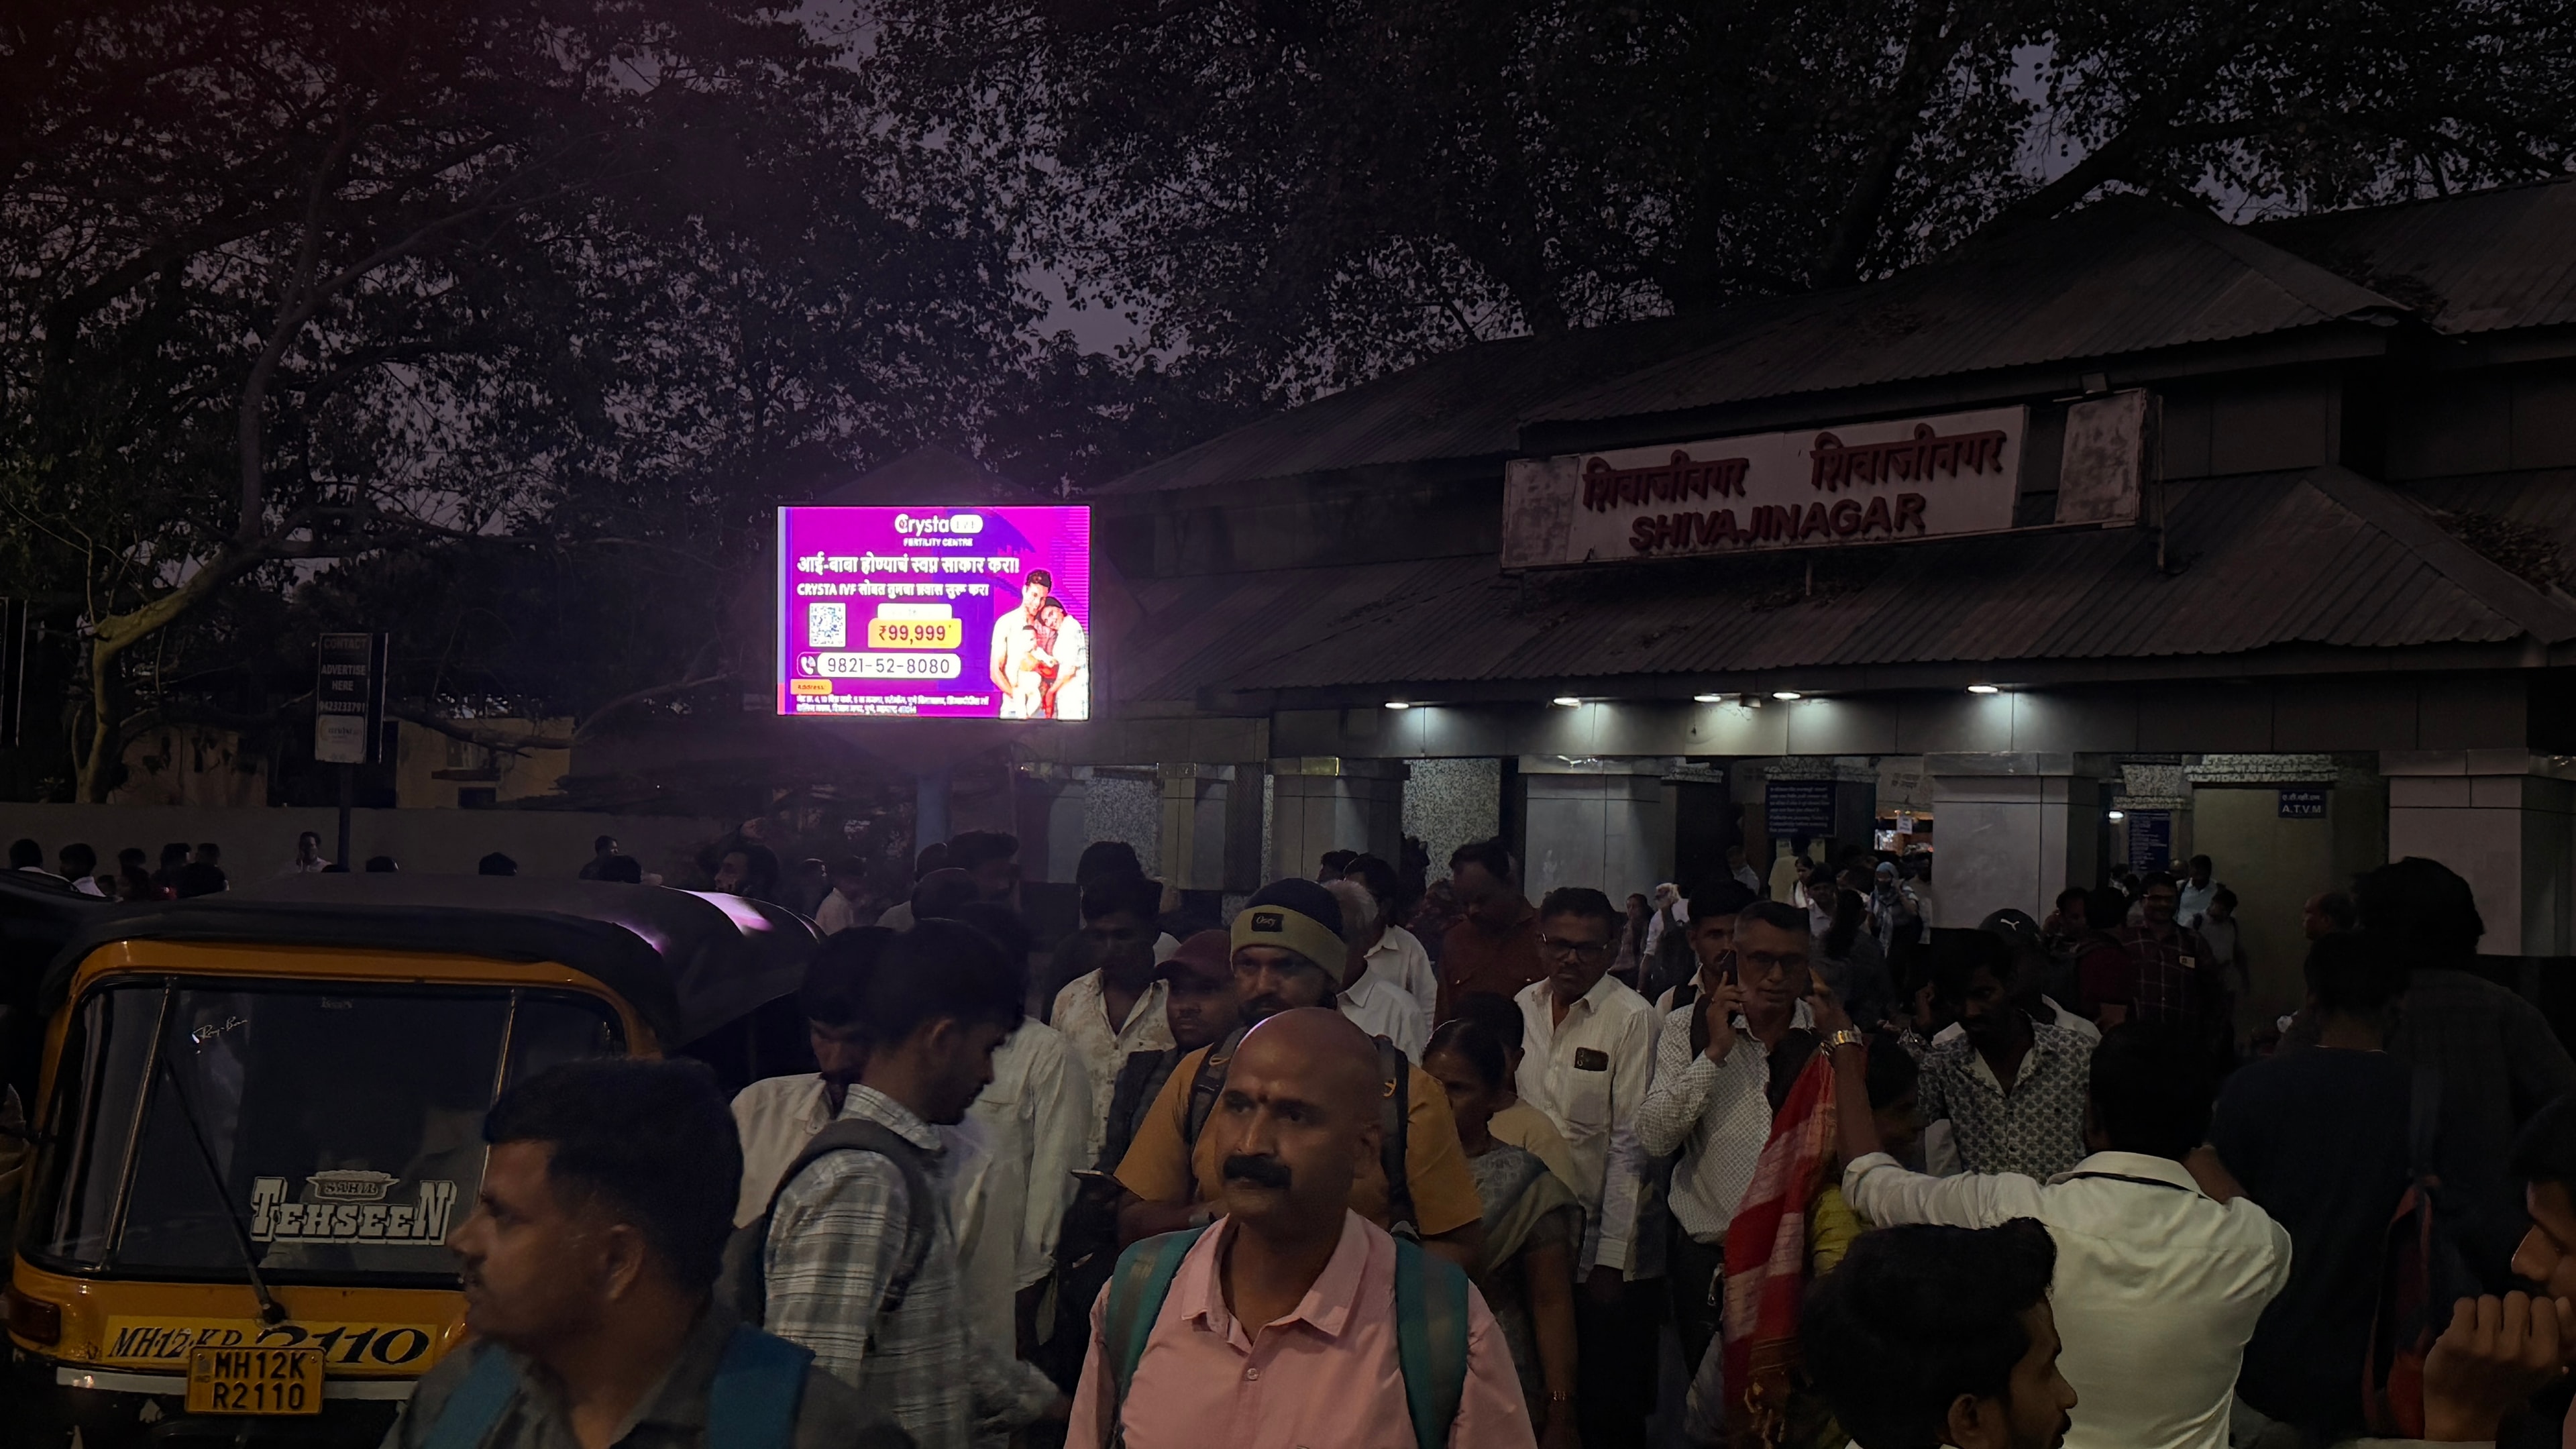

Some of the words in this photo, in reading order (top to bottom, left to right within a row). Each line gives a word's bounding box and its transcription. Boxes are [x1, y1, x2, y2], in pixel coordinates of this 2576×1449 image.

[1810, 423, 2006, 492] शिवाजीनगर
[1582, 449, 1750, 513] शिवाजीनगर
[894, 513, 950, 537] Crysta
[1629, 493, 1925, 553] SHIVAJINAGAR
[903, 537, 941, 547] FERTILITY
[942, 537, 973, 547] CENTRE
[941, 557, 985, 574] साकार
[797, 583, 838, 596] CRYSTA
[839, 583, 857, 596] IVF
[968, 583, 989, 596] करा
[324, 639, 366, 649] CONTACT
[321, 664, 366, 676] ADVERTISE
[827, 657, 950, 674] 9821-52-8080
[332, 680, 354, 691] HERE
[250, 1177, 457, 1246] TEHSEEN
[214, 1350, 306, 1379] MH12K
[213, 1381, 304, 1410] R2110
